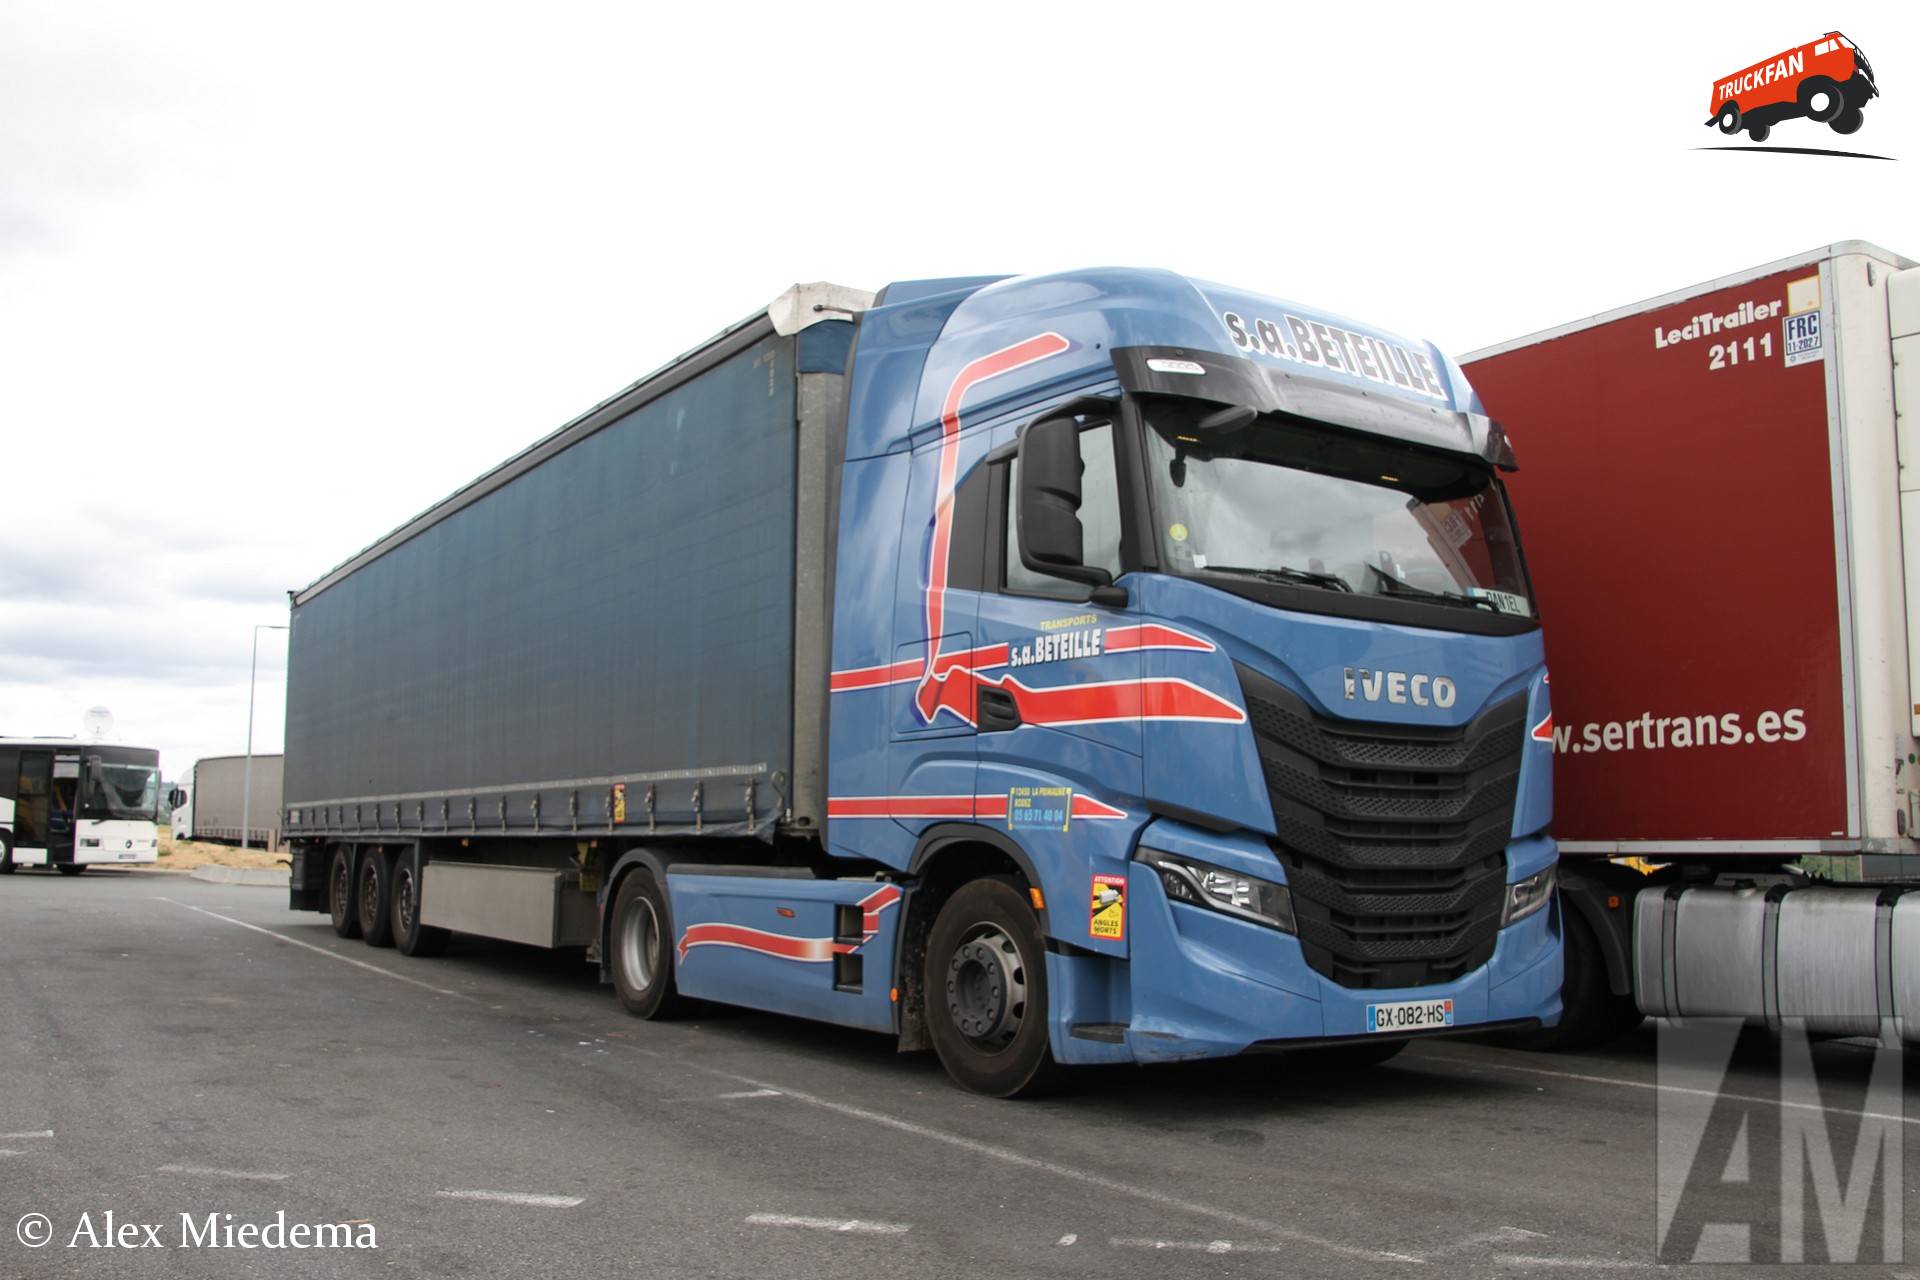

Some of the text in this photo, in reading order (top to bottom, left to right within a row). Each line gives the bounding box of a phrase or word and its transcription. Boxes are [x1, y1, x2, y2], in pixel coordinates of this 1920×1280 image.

[1654, 299, 1782, 349] LeciTrailer
[1787, 314, 1818, 340] FRC
[1708, 332, 1773, 371] 2111
[1040, 613, 1098, 631] TRANSPORTS
[1343, 667, 1456, 708] IVECO
[1094, 919, 1119, 927] ANGLES
[1376, 1004, 1444, 1027] GX-082-HS
